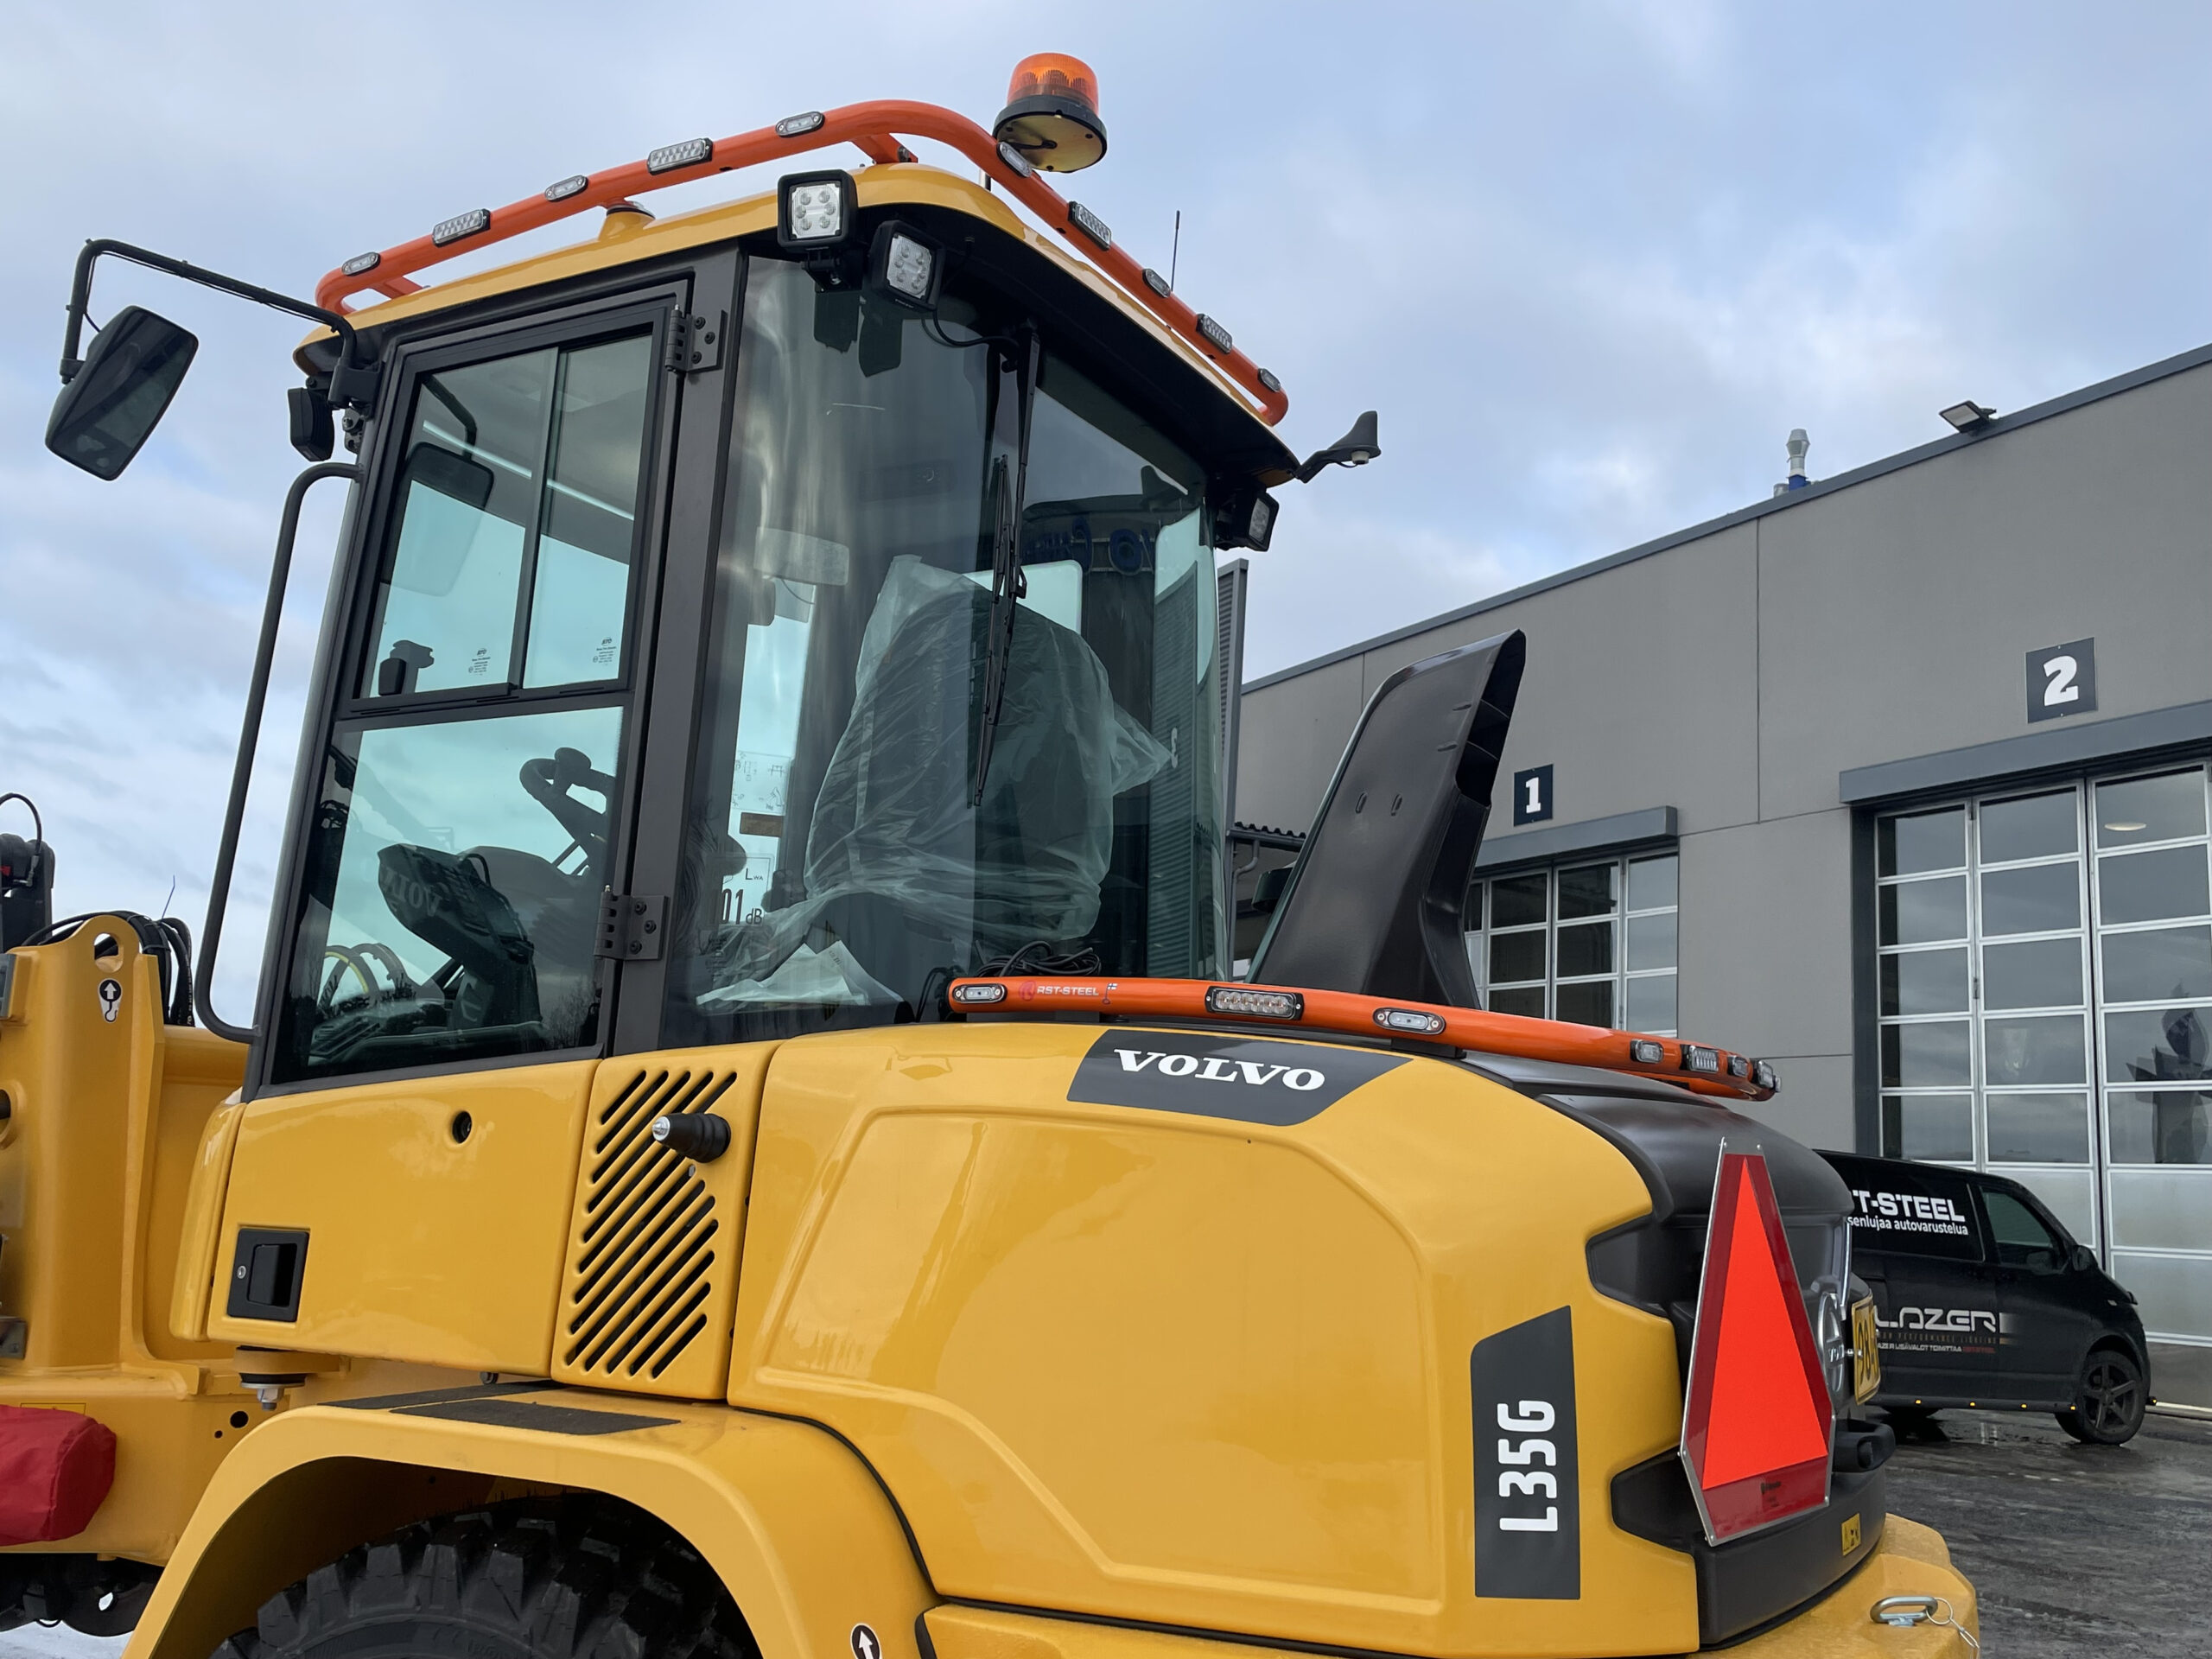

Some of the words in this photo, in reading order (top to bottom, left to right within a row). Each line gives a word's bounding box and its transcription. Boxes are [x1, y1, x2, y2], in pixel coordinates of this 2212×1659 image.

[2044, 655, 2079, 707] 2
[1525, 777, 1541, 814] 1
[721, 887, 744, 925] 01
[746, 907, 763, 925] dB
[1036, 985, 1100, 996] RST-STEEL
[1113, 1048, 1325, 1090] VOLVO
[1852, 1189, 1966, 1223] T-STEEL
[1847, 1215, 1892, 1231] senlujaa
[1893, 1219, 1969, 1236] autovarustelua
[1872, 1305, 1996, 1332] LAZER
[1497, 1400, 1559, 1532] L35G
